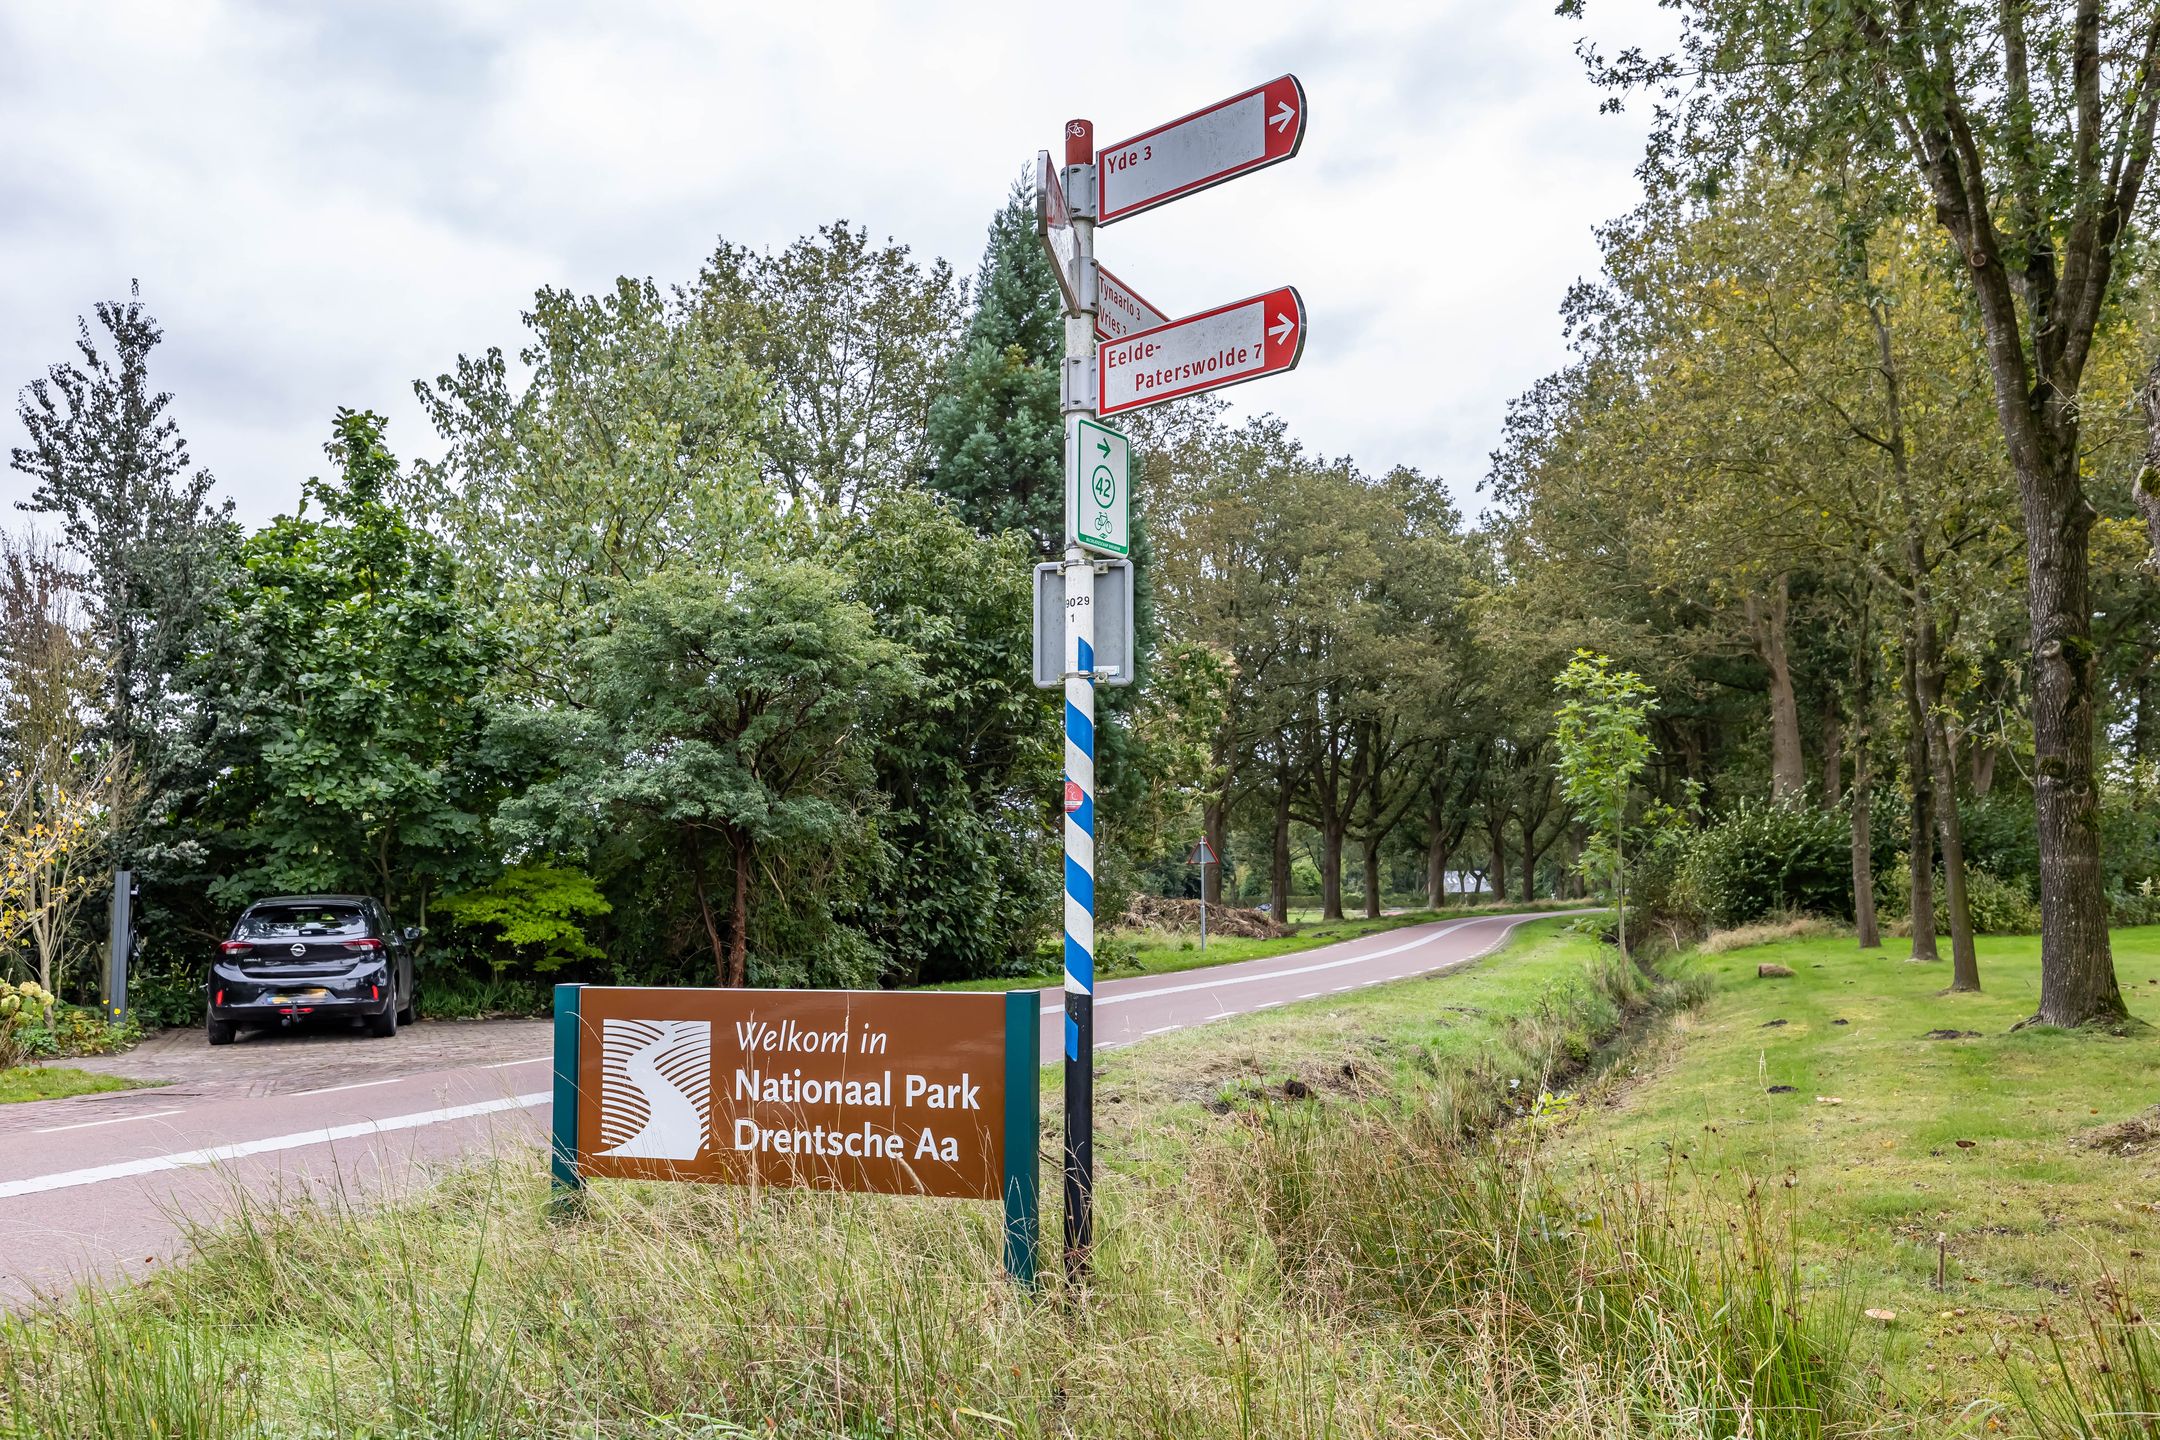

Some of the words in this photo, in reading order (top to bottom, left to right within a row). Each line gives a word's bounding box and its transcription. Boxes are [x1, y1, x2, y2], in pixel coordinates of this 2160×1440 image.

[1107, 151, 1138, 175] Yde
[1144, 145, 1152, 161] 3
[1099, 275, 1135, 316] Tynaarlo
[1136, 307, 1141, 321] 3
[1099, 304, 1121, 335] Vries
[1108, 343, 1162, 369] Eelde-
[1135, 348, 1247, 391] Paterswolde
[1254, 344, 1263, 359] 7
[1095, 476, 1111, 498] 42
[735, 1019, 849, 1053] Welkom
[860, 1022, 888, 1055] in
[734, 1069, 892, 1107] Nationaal
[905, 1073, 981, 1110] Park
[734, 1118, 904, 1160] Drentsche
[913, 1127, 960, 1162] Aa
